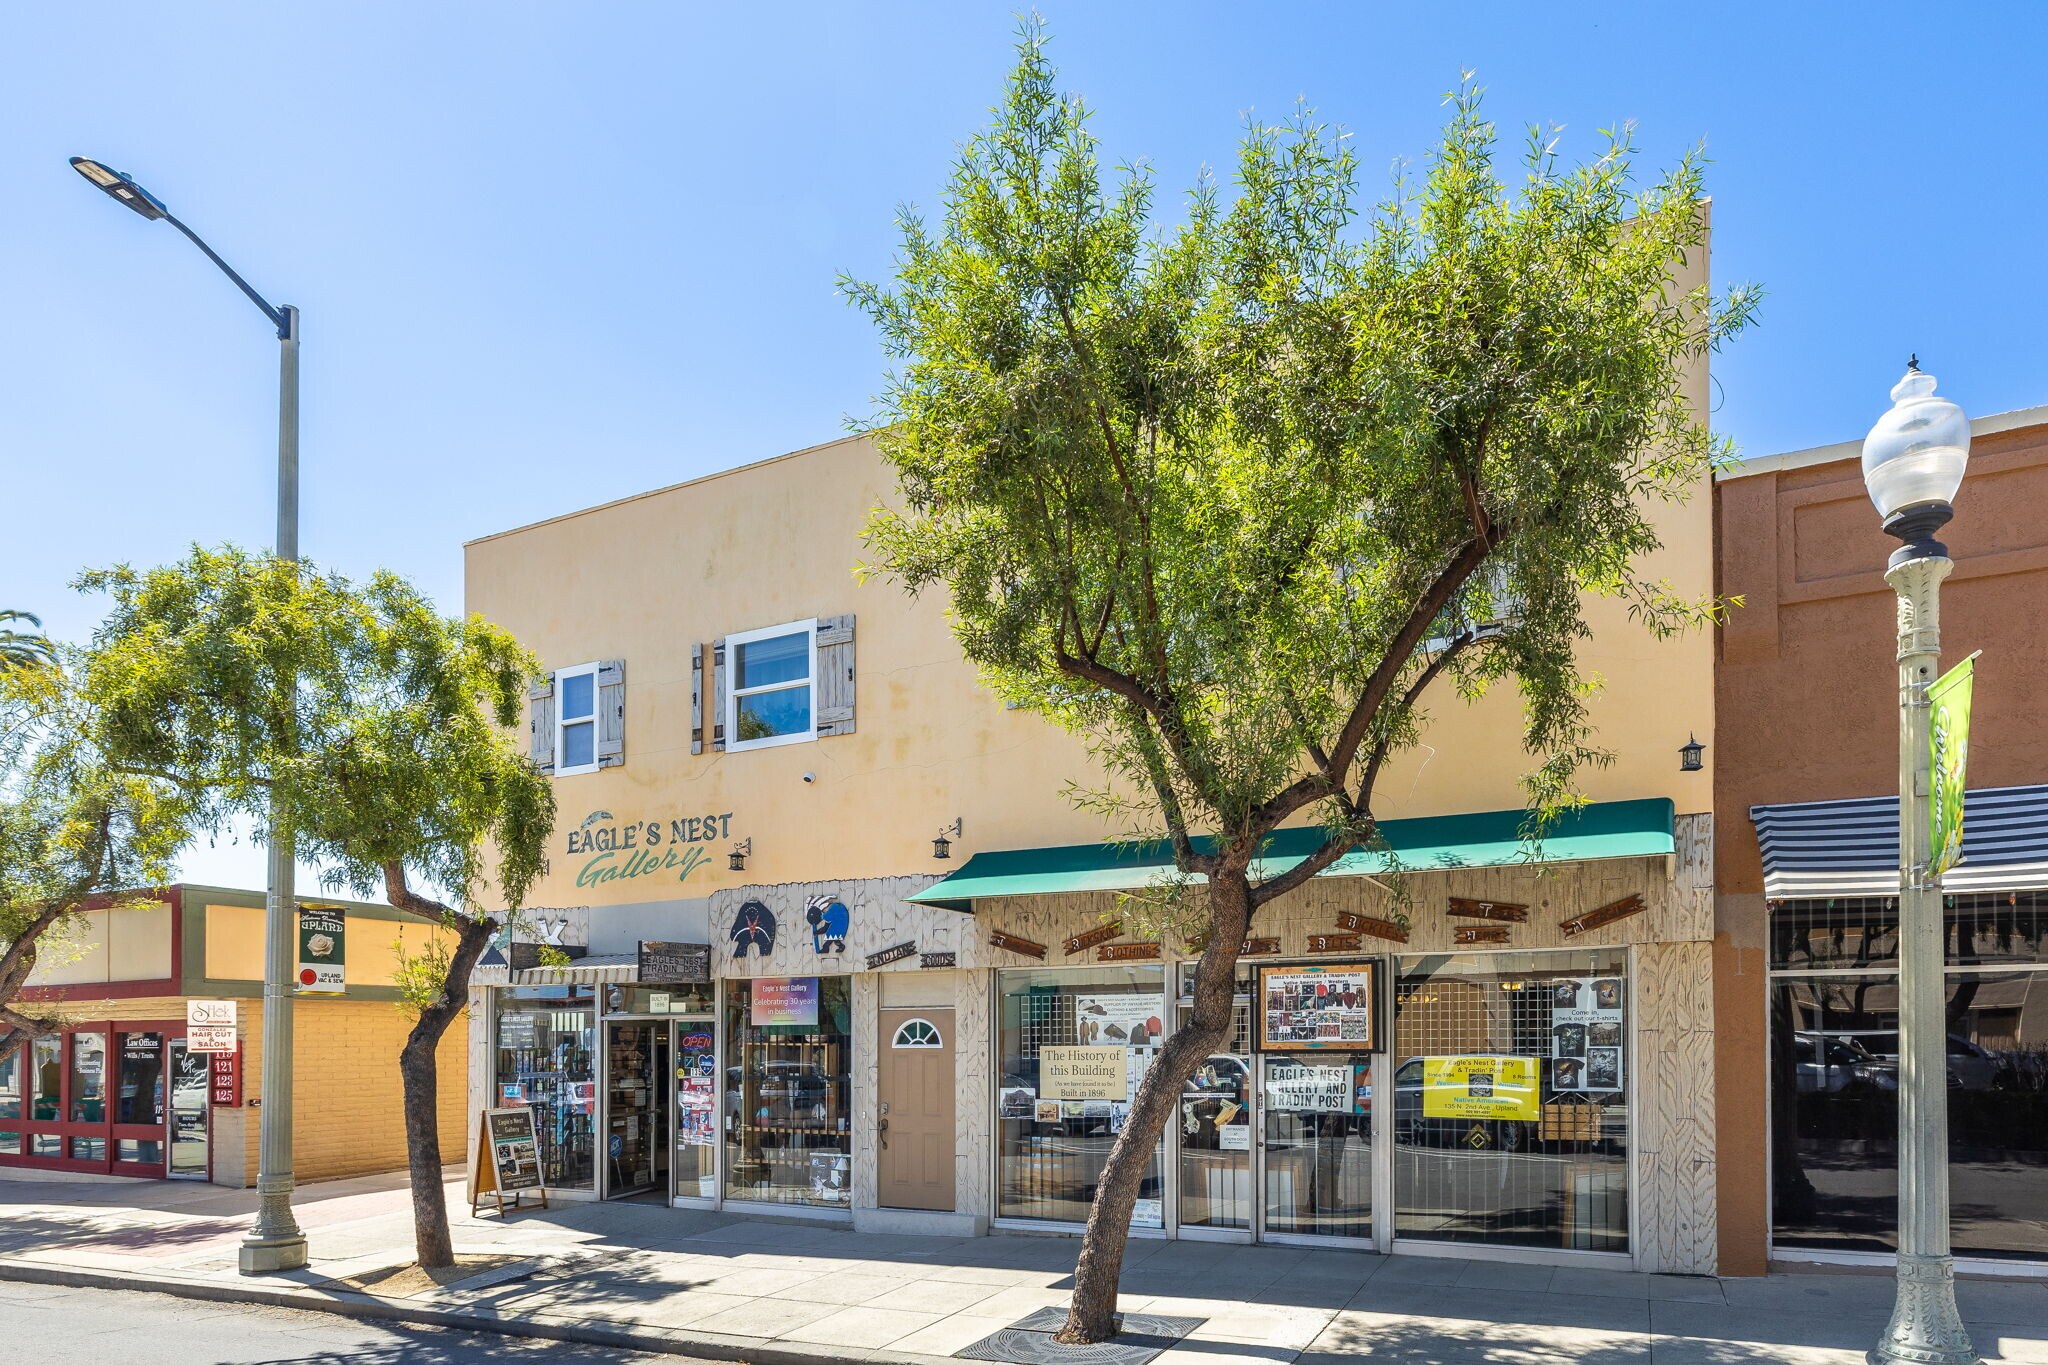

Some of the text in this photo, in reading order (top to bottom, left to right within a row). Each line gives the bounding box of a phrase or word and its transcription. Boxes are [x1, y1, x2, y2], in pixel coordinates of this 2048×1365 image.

[567, 812, 733, 854] EAGLE'S NEST
[576, 846, 712, 889] Gallery
[301, 921, 343, 932] UPLAND
[646, 955, 679, 964] EAGLES
[873, 944, 911, 966] INDIAN
[647, 964, 704, 974] TRADIN POST
[753, 997, 817, 1006] Celebrating 30 years
[138, 1038, 158, 1046] Offices
[682, 1036, 712, 1048] OPEN
[1045, 1049, 1121, 1063] The History of
[215, 1062, 232, 1072] 121
[1050, 1065, 1115, 1078] this Building
[215, 1076, 232, 1086] 123
[1271, 1069, 1348, 1082] EAGLE'S NEST
[1060, 1089, 1106, 1097] Built in 1896
[1326, 1083, 1347, 1094] AND
[215, 1090, 232, 1101] 125
[1271, 1094, 1345, 1108] TRADIN' POST
